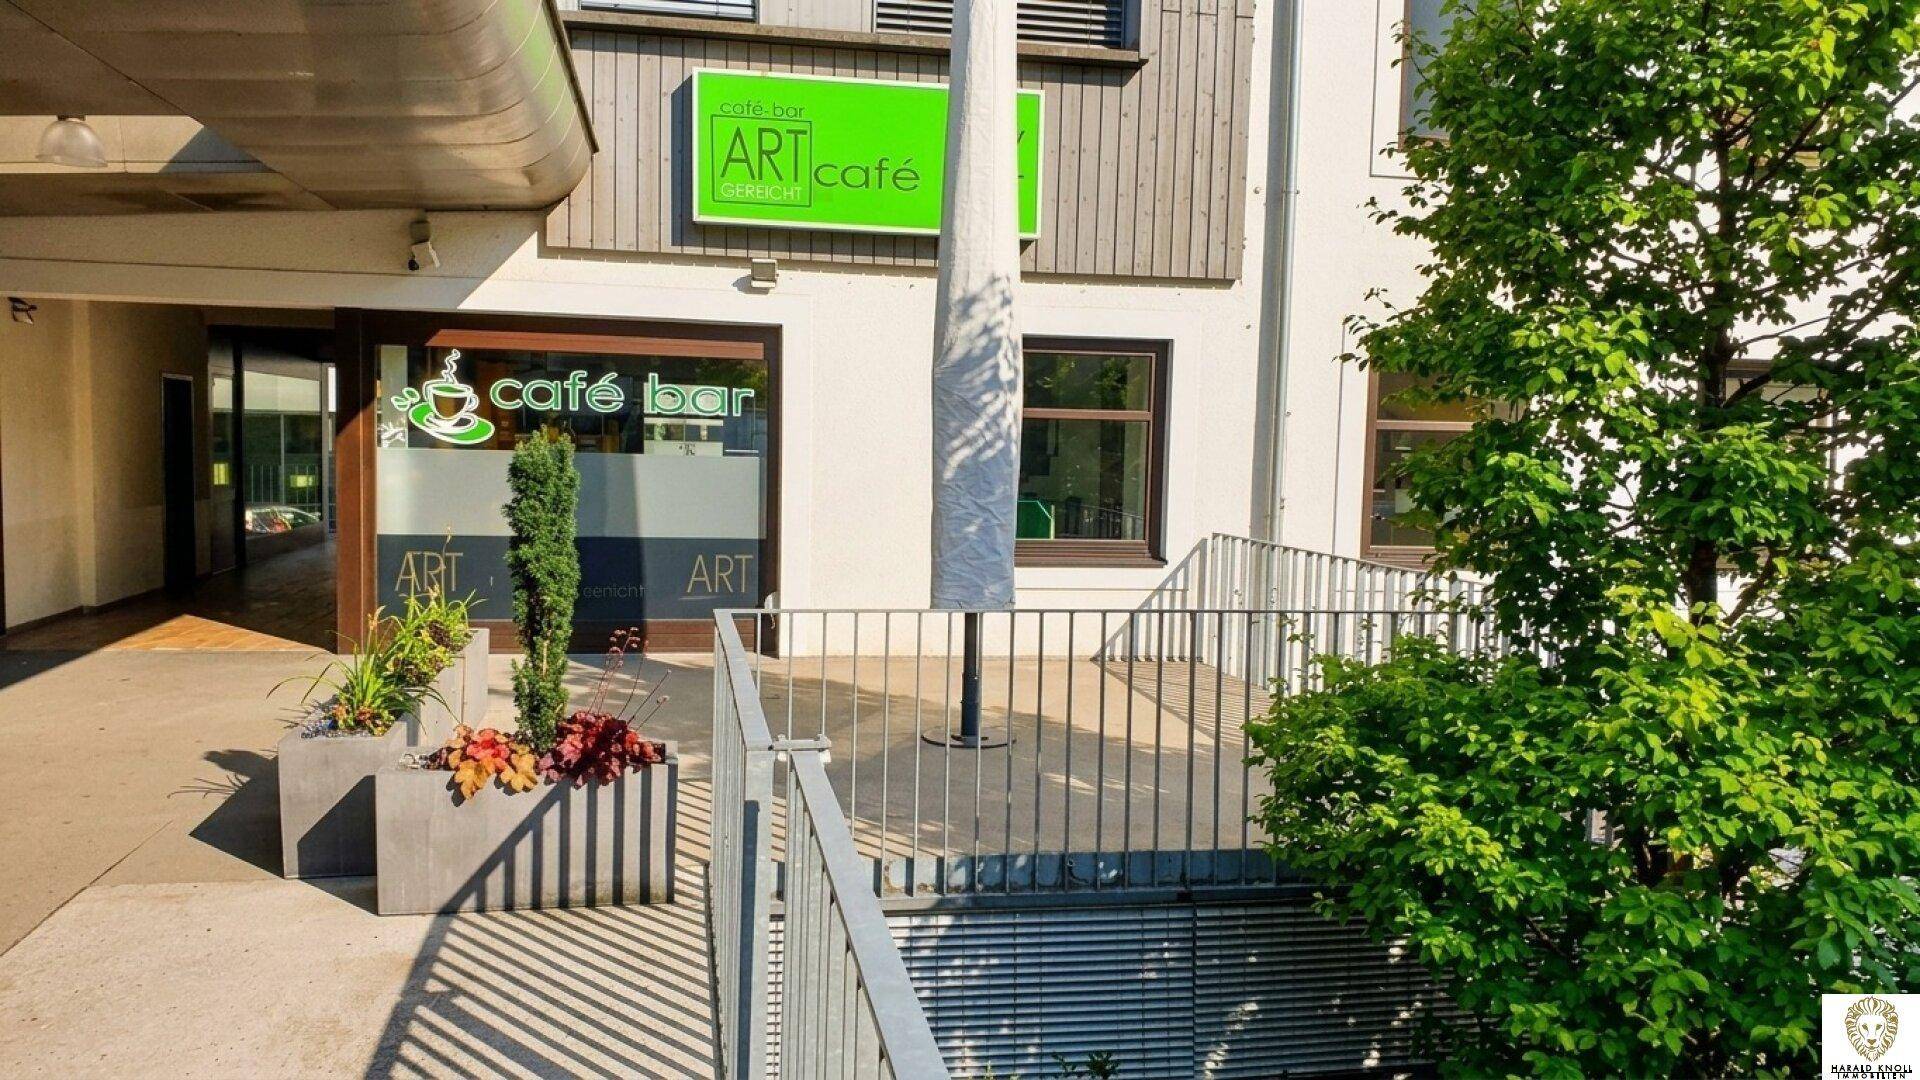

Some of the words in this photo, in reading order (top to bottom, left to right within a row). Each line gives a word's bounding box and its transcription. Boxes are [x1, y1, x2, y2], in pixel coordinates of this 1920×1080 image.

[720, 126, 807, 183] ART
[814, 157, 920, 191] café
[721, 183, 802, 200] GEREICHT
[489, 370, 625, 413] café
[648, 372, 755, 416] bar
[394, 551, 464, 592] ART
[687, 554, 753, 593] ART
